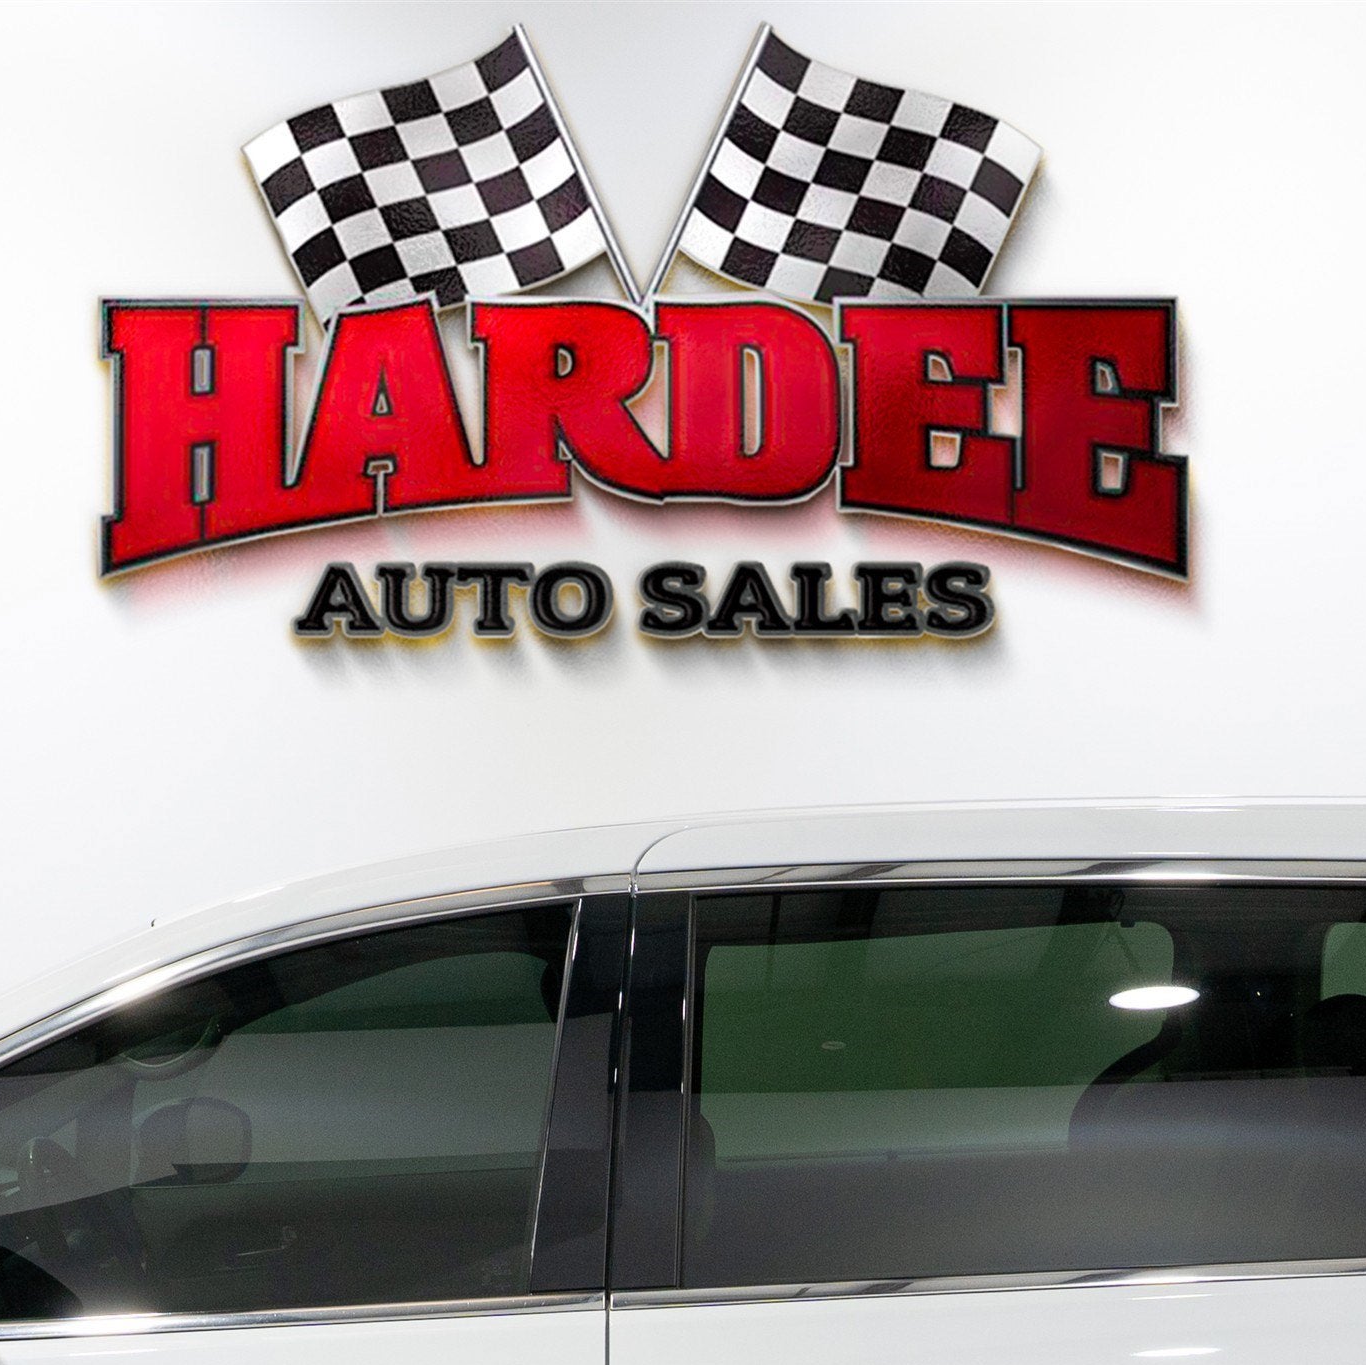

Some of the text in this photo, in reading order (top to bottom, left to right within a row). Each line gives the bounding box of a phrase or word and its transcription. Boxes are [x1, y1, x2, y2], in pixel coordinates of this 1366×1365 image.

[99, 296, 1188, 580] HARDEE
[295, 562, 993, 638] AUTO SALES
